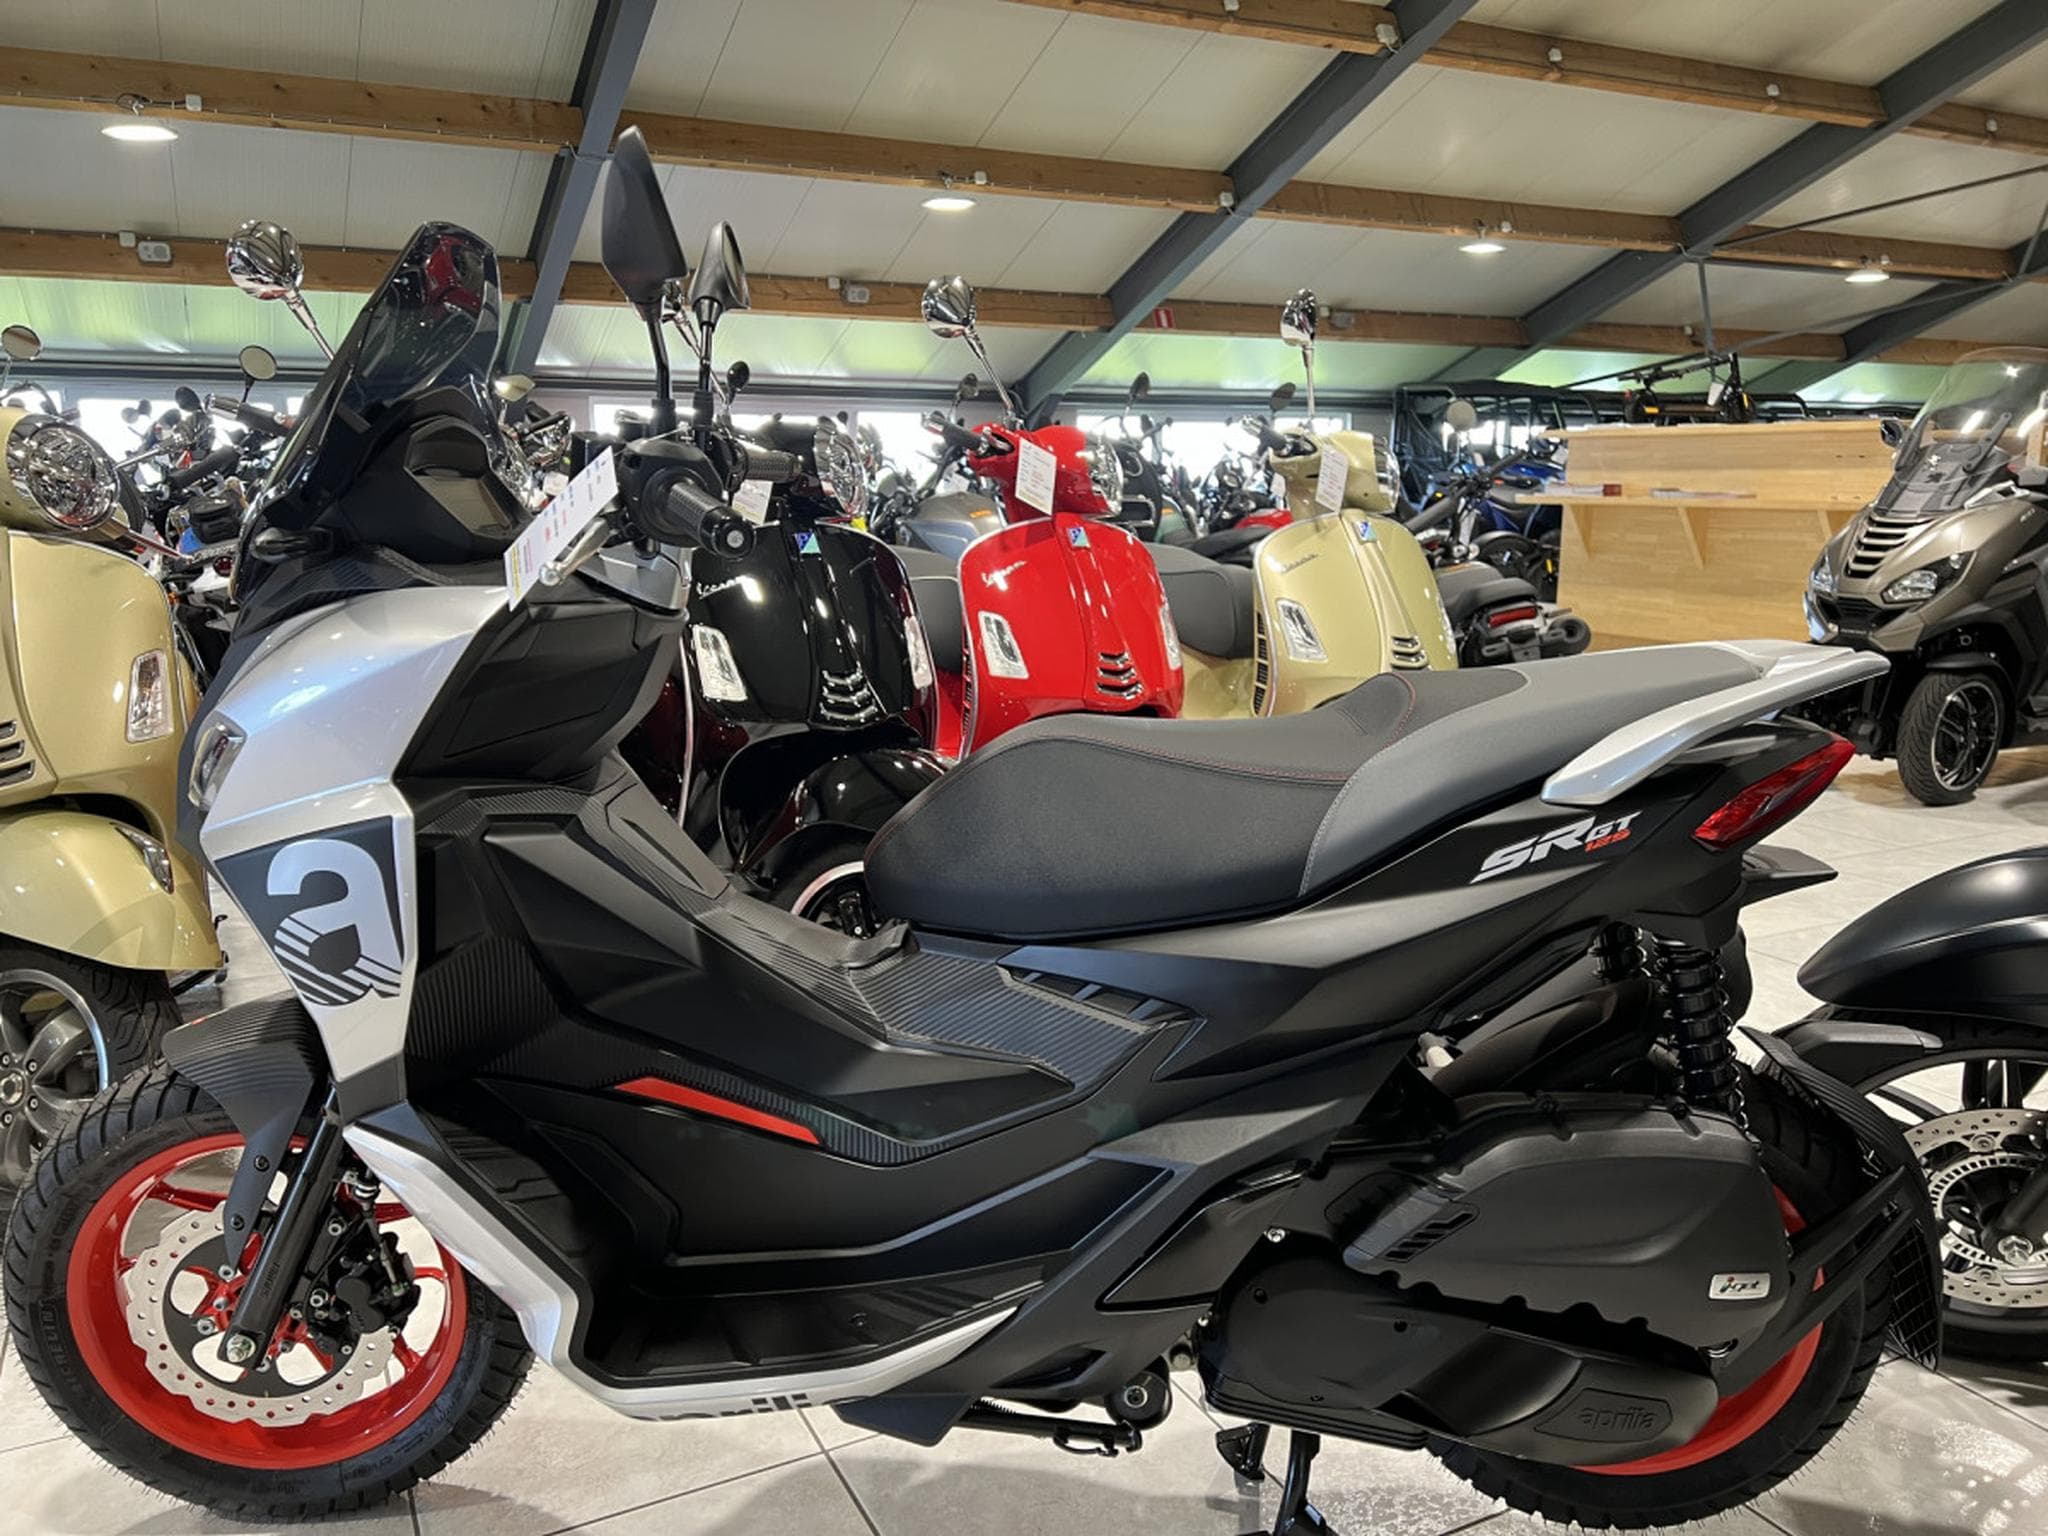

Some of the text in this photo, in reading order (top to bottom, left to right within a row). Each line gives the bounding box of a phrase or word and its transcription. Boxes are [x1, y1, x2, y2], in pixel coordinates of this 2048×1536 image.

[1469, 810, 1643, 885] SR GT
[1580, 1405, 1659, 1431] aprilia
